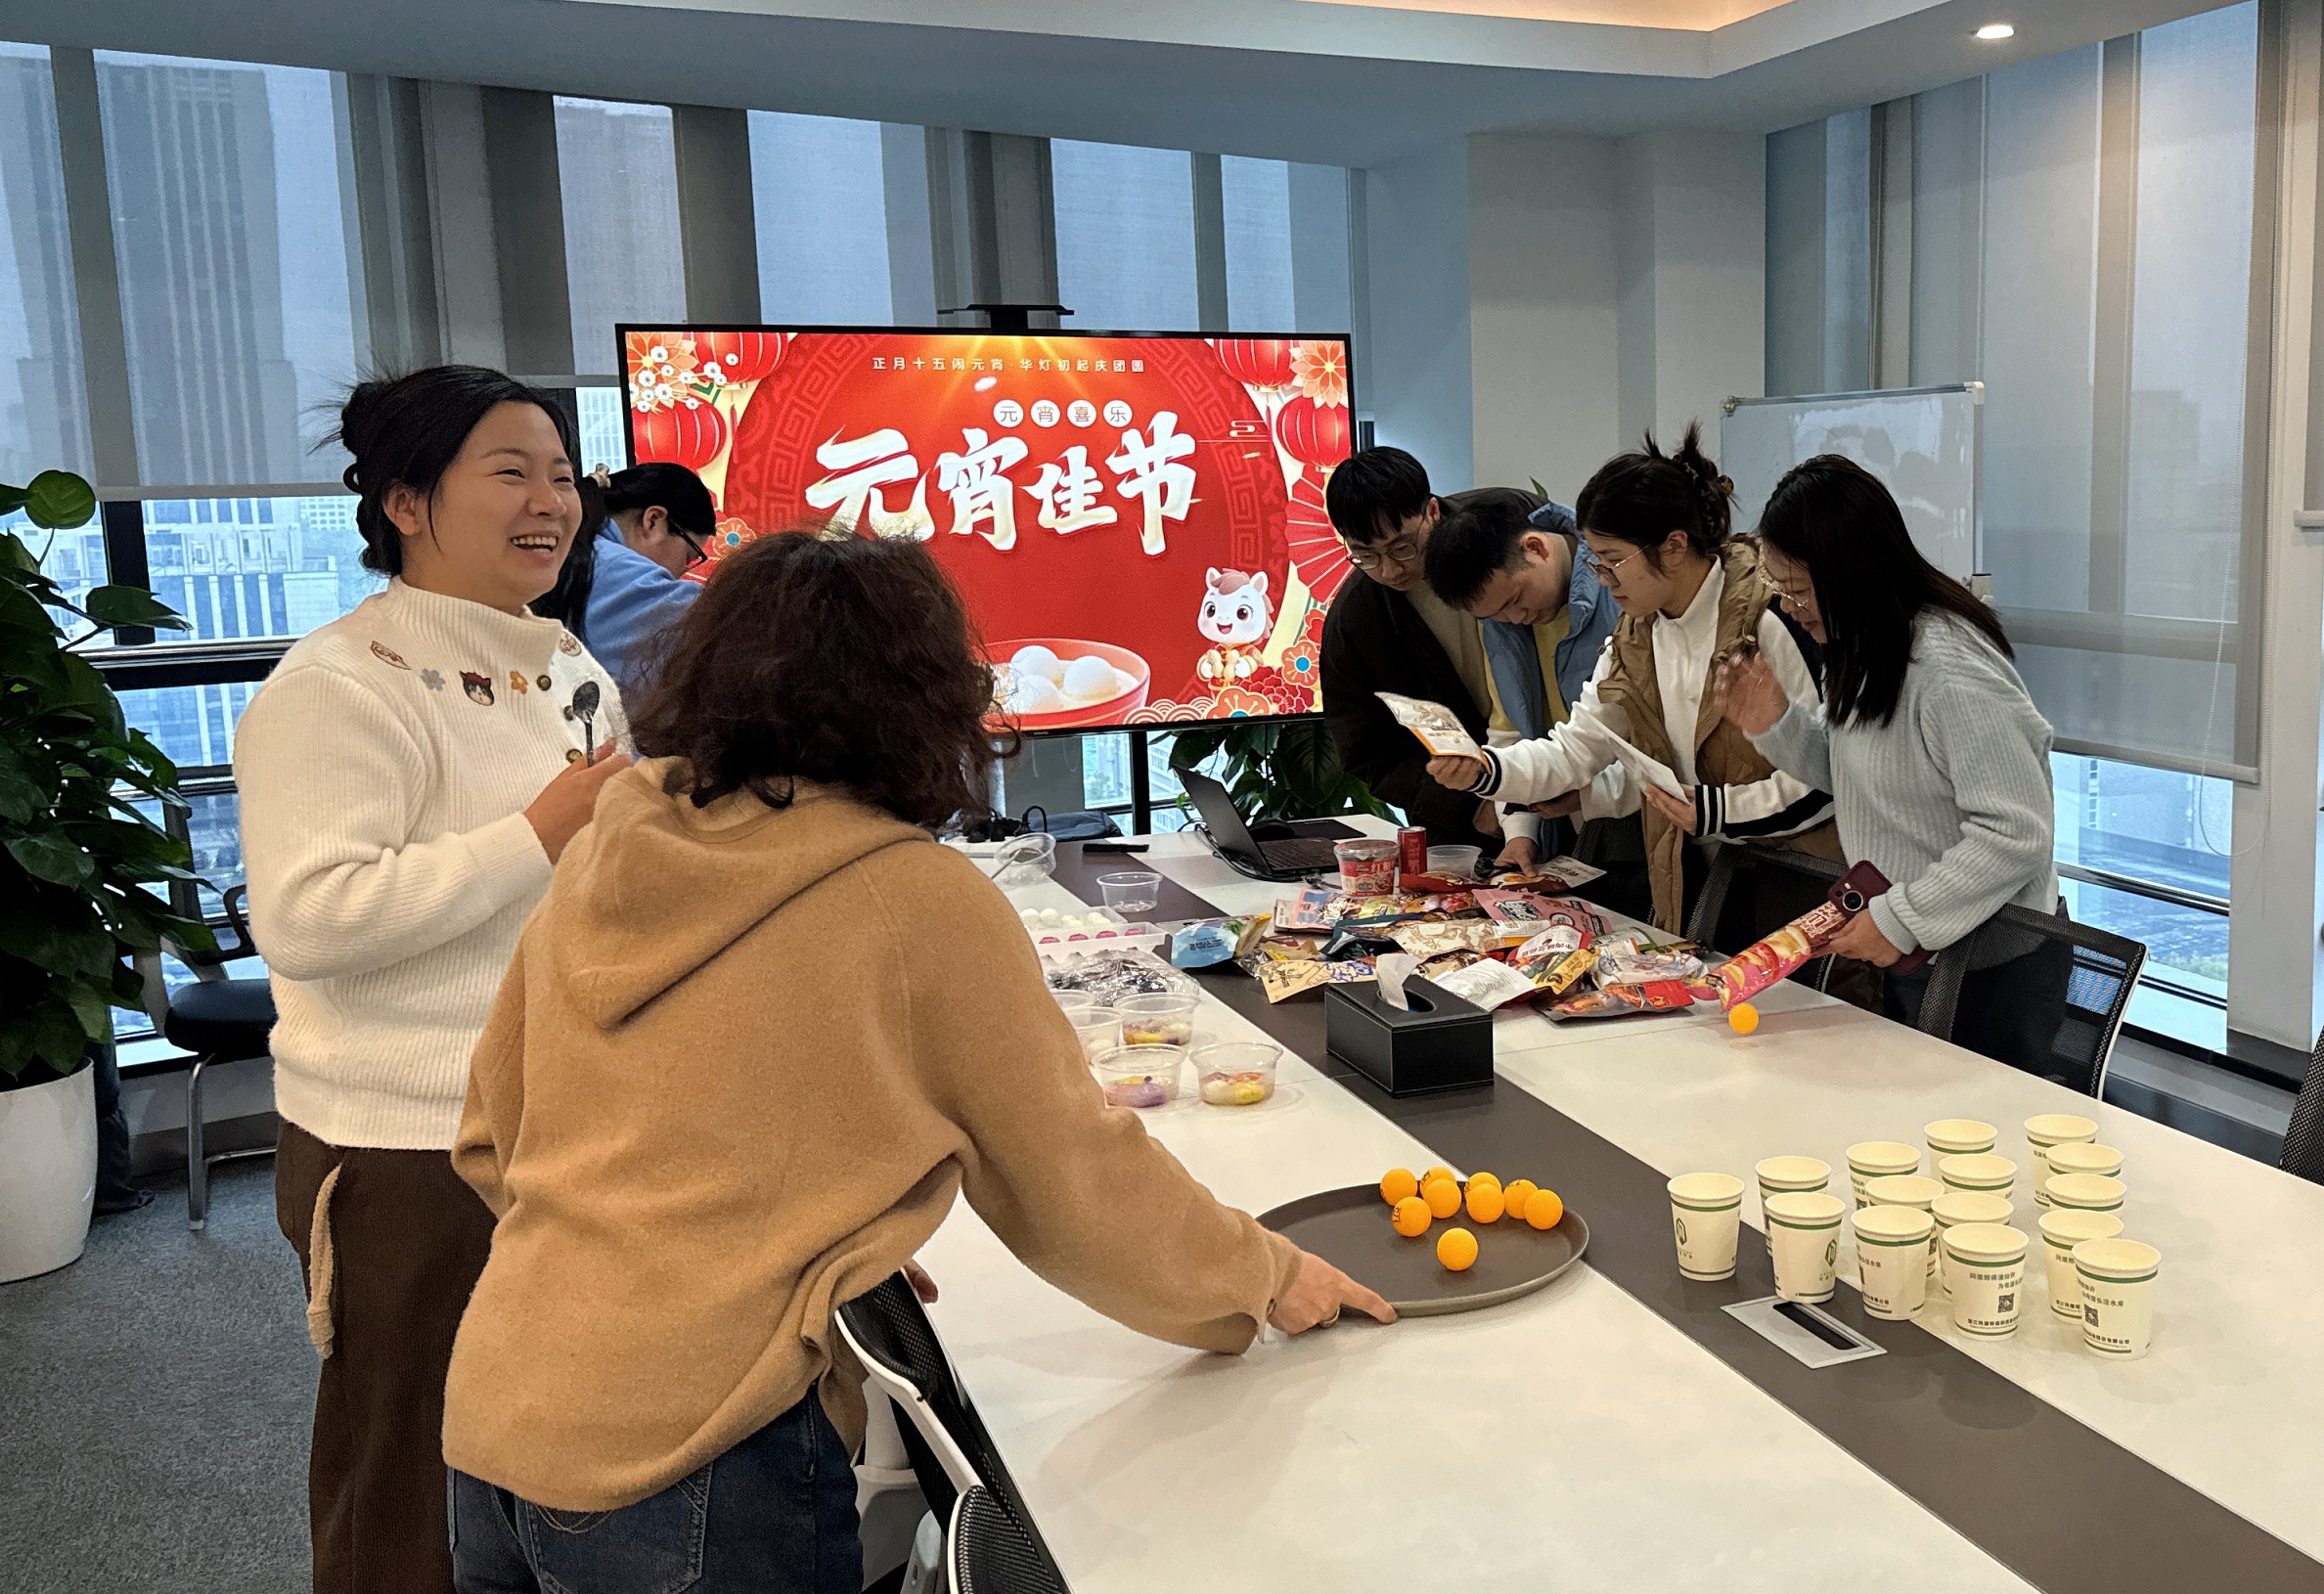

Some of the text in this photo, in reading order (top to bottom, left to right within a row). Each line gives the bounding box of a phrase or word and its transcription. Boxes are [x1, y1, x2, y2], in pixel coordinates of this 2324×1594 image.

[872, 356, 1145, 374] 正月十五闹元宵 华灯初起庆团圆
[997, 402, 1131, 425] 元宵喜乐
[806, 411, 1201, 556] 元宵佳节
